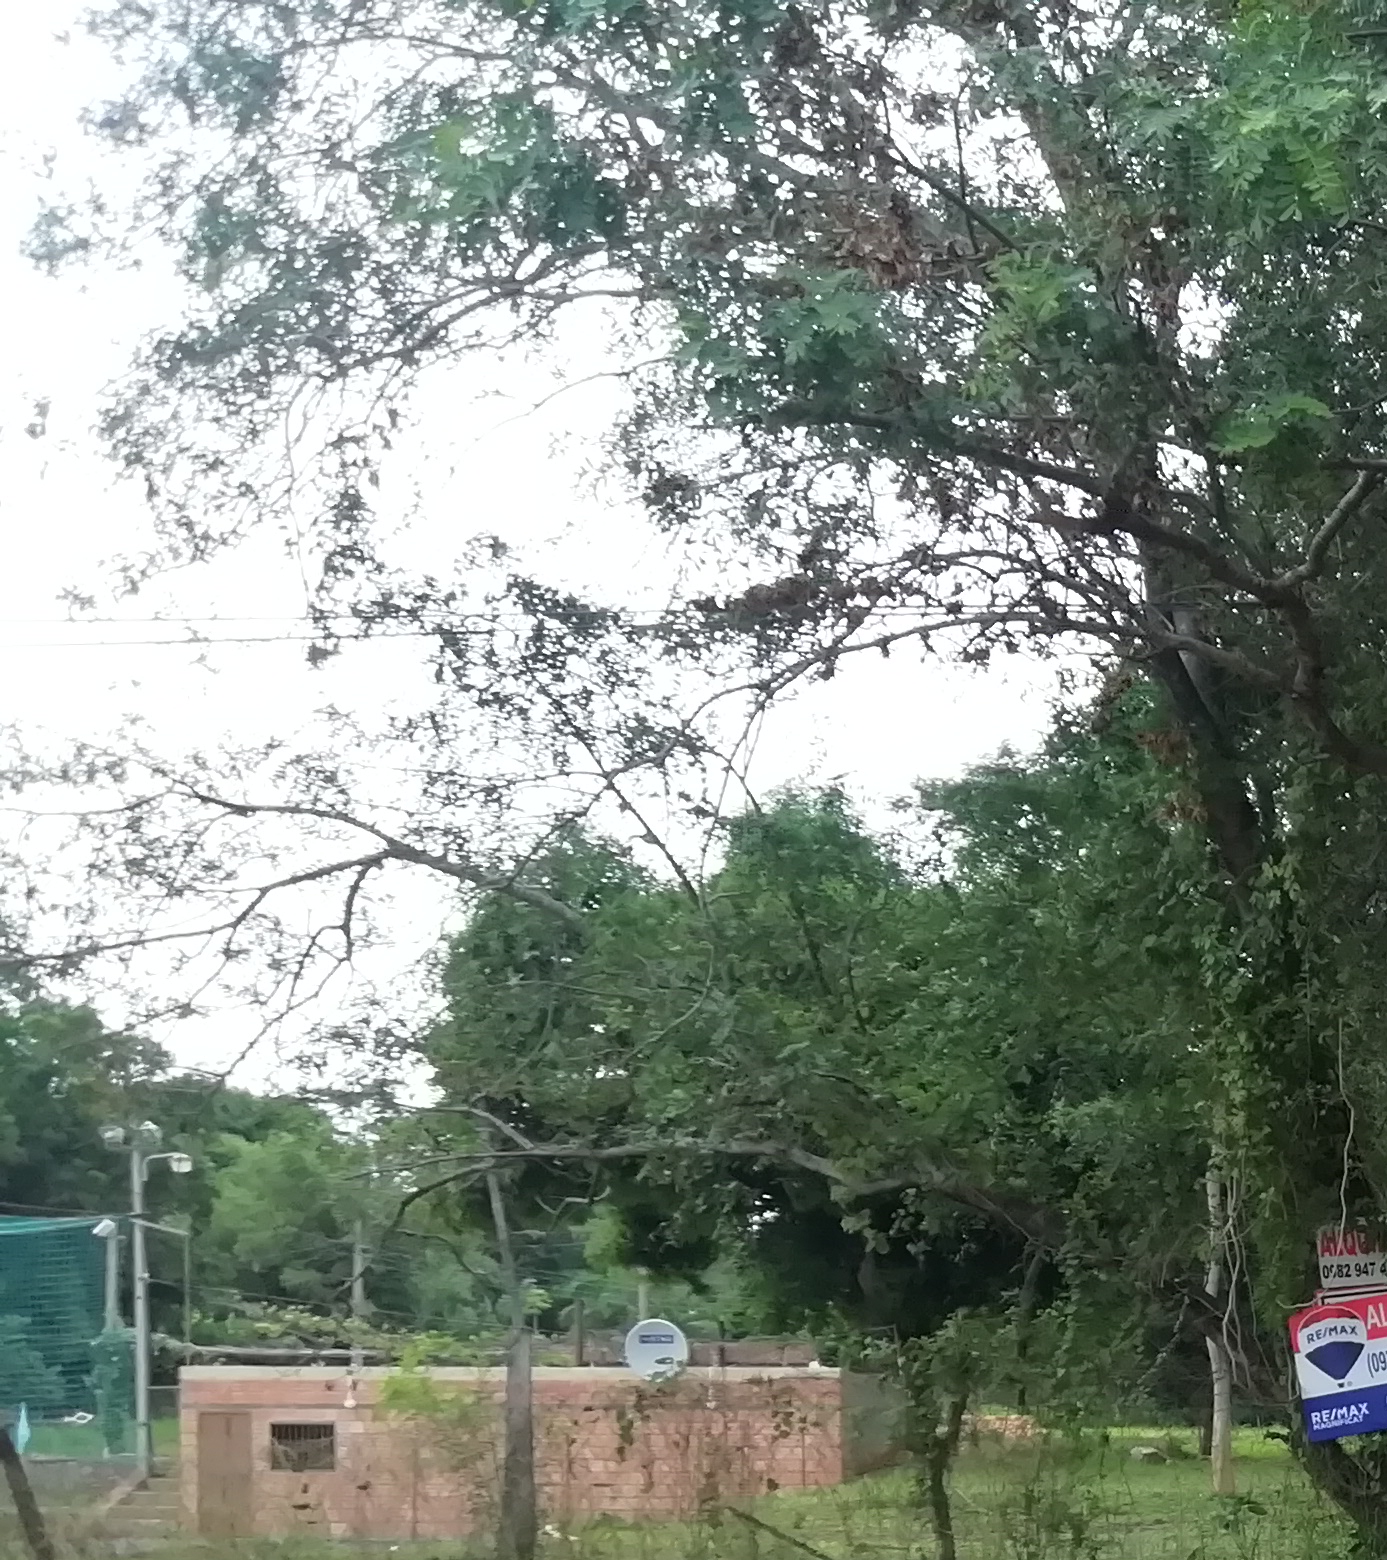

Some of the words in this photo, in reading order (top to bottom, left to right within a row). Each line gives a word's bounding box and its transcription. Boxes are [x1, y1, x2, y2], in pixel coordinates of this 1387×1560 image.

[1355, 1261, 1376, 1277] 947
[1306, 1324, 1359, 1344] RE/MAX
[1310, 1402, 1370, 1424] RE/MAX
